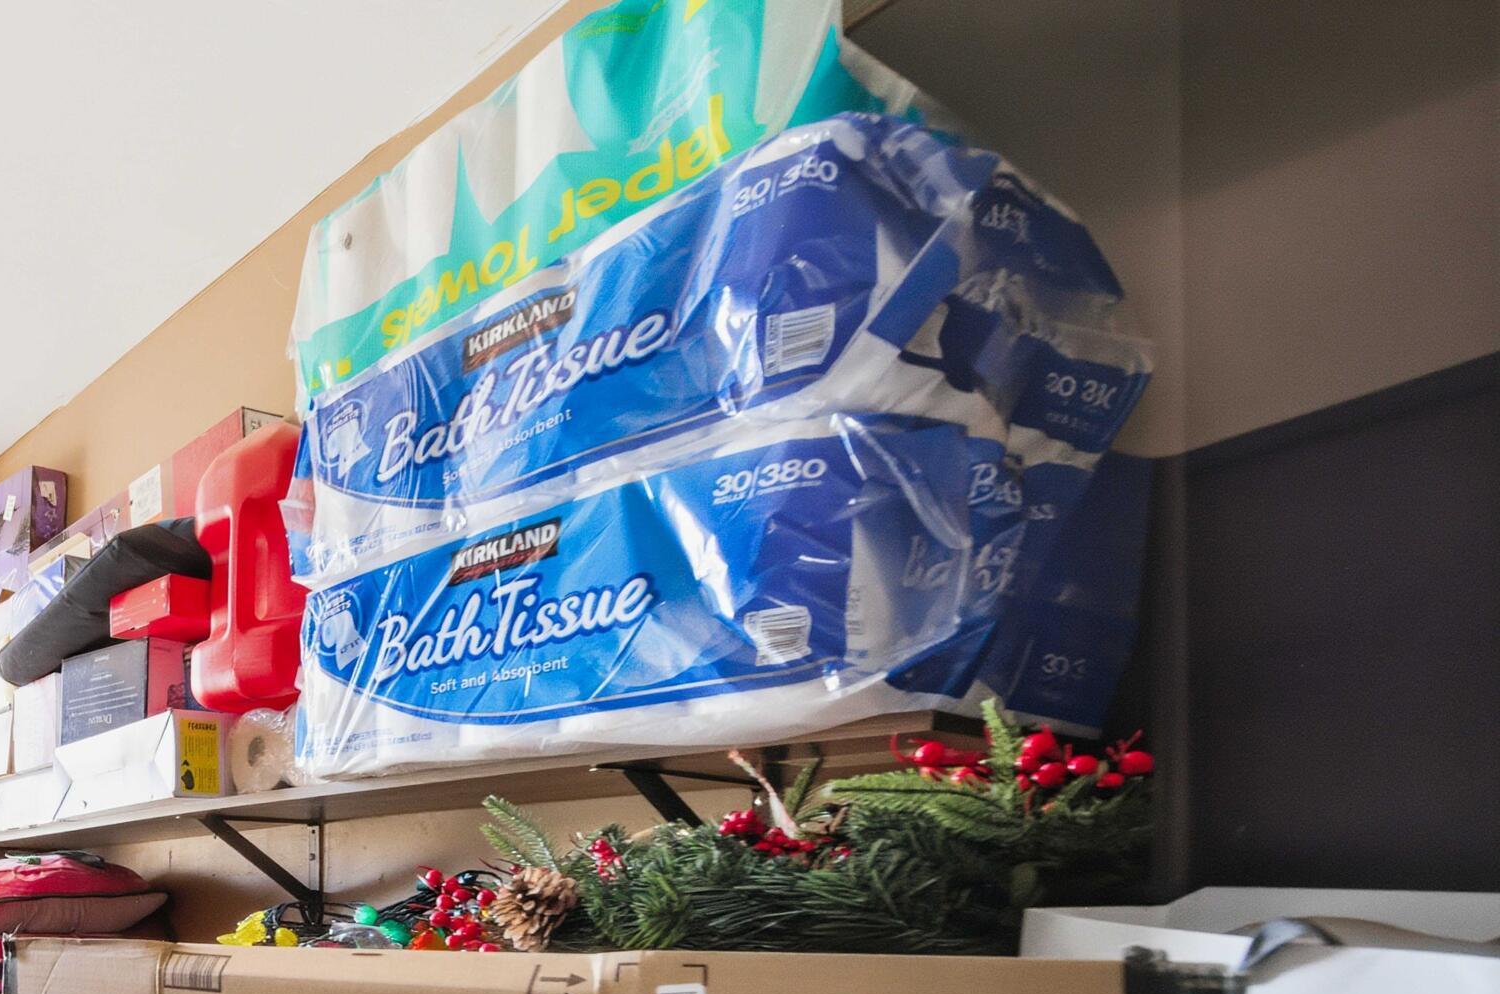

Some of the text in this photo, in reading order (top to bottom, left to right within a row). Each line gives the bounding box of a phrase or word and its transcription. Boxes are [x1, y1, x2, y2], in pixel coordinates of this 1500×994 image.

[380, 230, 539, 350] Towels
[466, 291, 577, 357] KIRKLAND
[376, 370, 501, 483] Bath
[499, 311, 672, 425] Tissue
[712, 471, 752, 498] 30
[757, 457, 828, 488] 380
[453, 524, 558, 572] KIRKLAND
[375, 574, 656, 682] Bath Tissue
[430, 656, 570, 696] Soft and Absorbent
